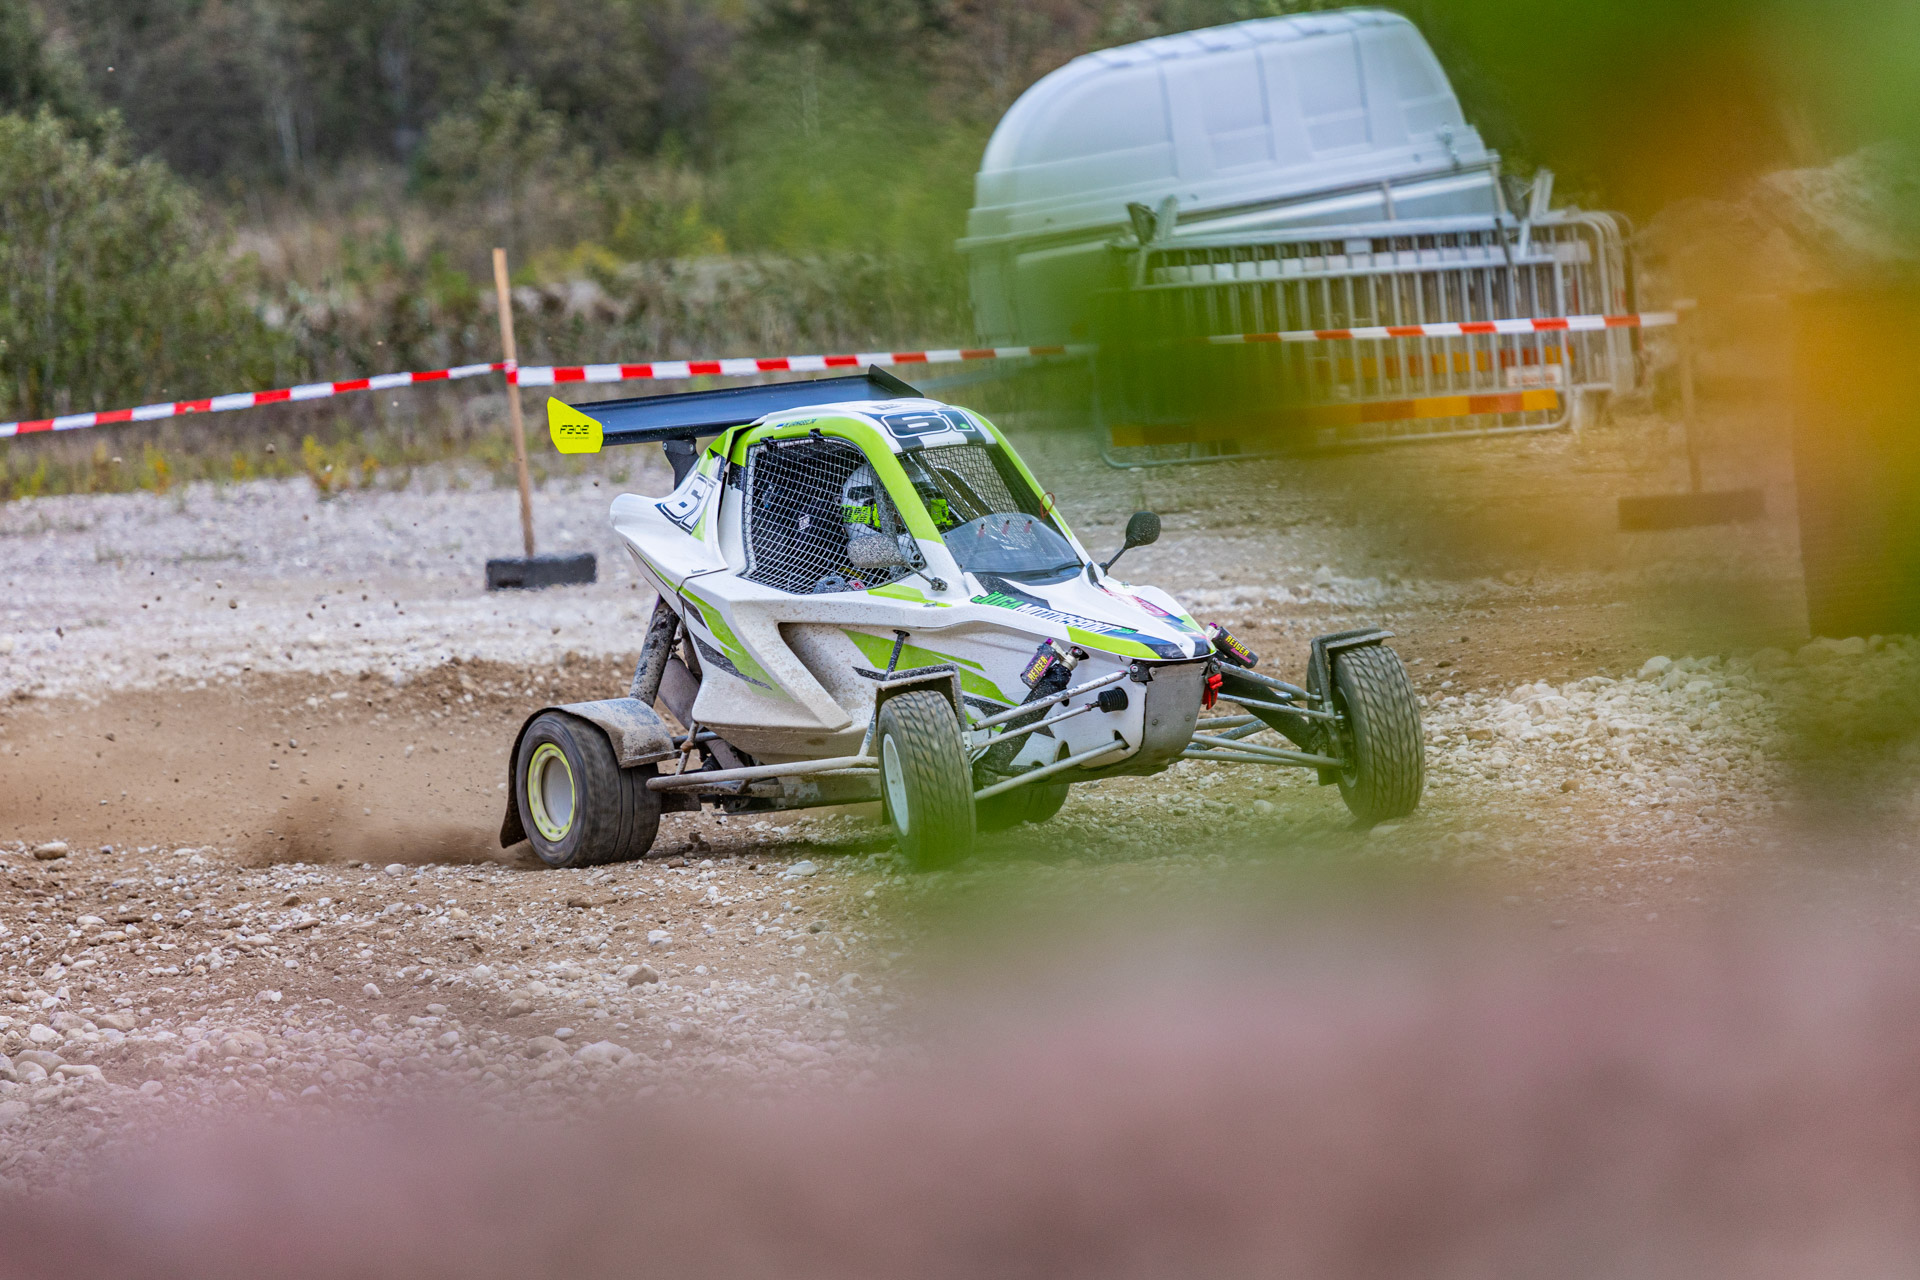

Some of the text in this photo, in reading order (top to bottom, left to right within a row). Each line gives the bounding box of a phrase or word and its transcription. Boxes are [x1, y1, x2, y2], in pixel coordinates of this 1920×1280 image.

[881, 410, 976, 438] 61
[1224, 634, 1251, 657] REIGER
[1027, 655, 1049, 683] REIGER
